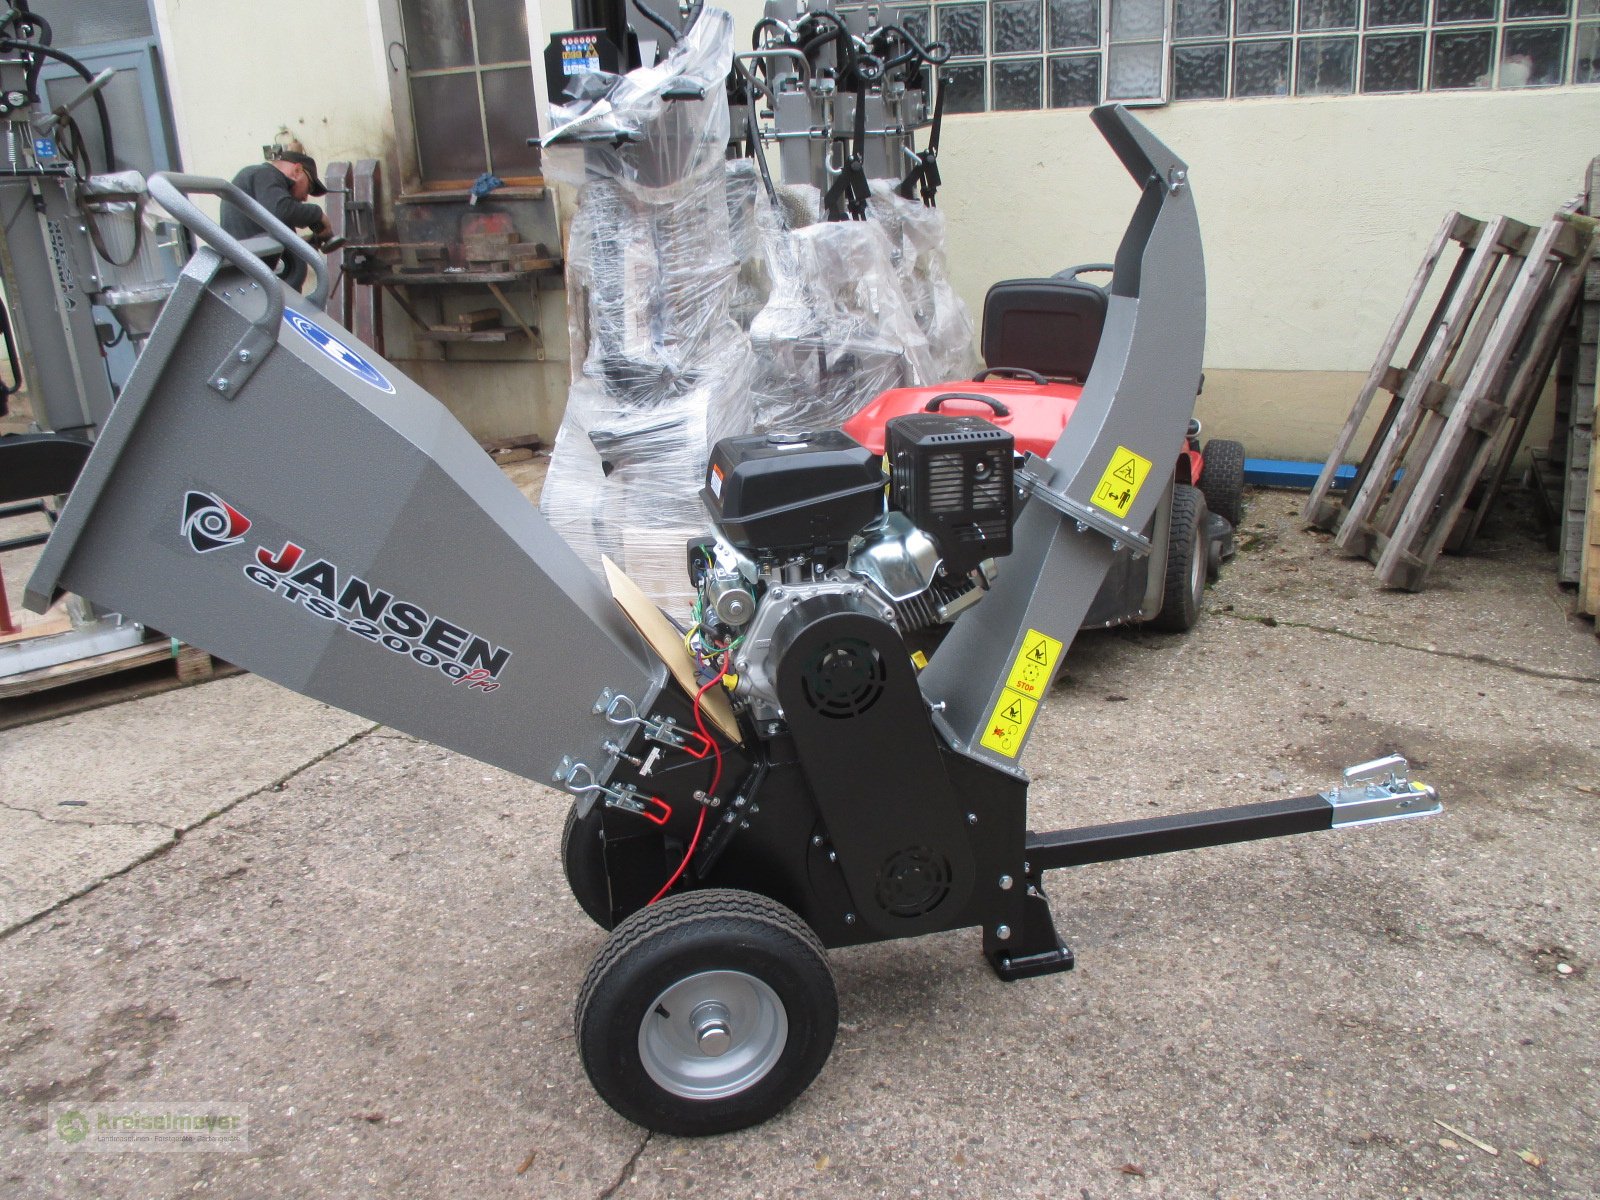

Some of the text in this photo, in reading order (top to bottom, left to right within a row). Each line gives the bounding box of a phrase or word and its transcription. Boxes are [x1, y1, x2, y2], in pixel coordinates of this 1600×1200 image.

[243, 564, 500, 693] GTS-2000 Pro
[255, 541, 513, 680] JANSEN
[1016, 680, 1035, 692] STOP
